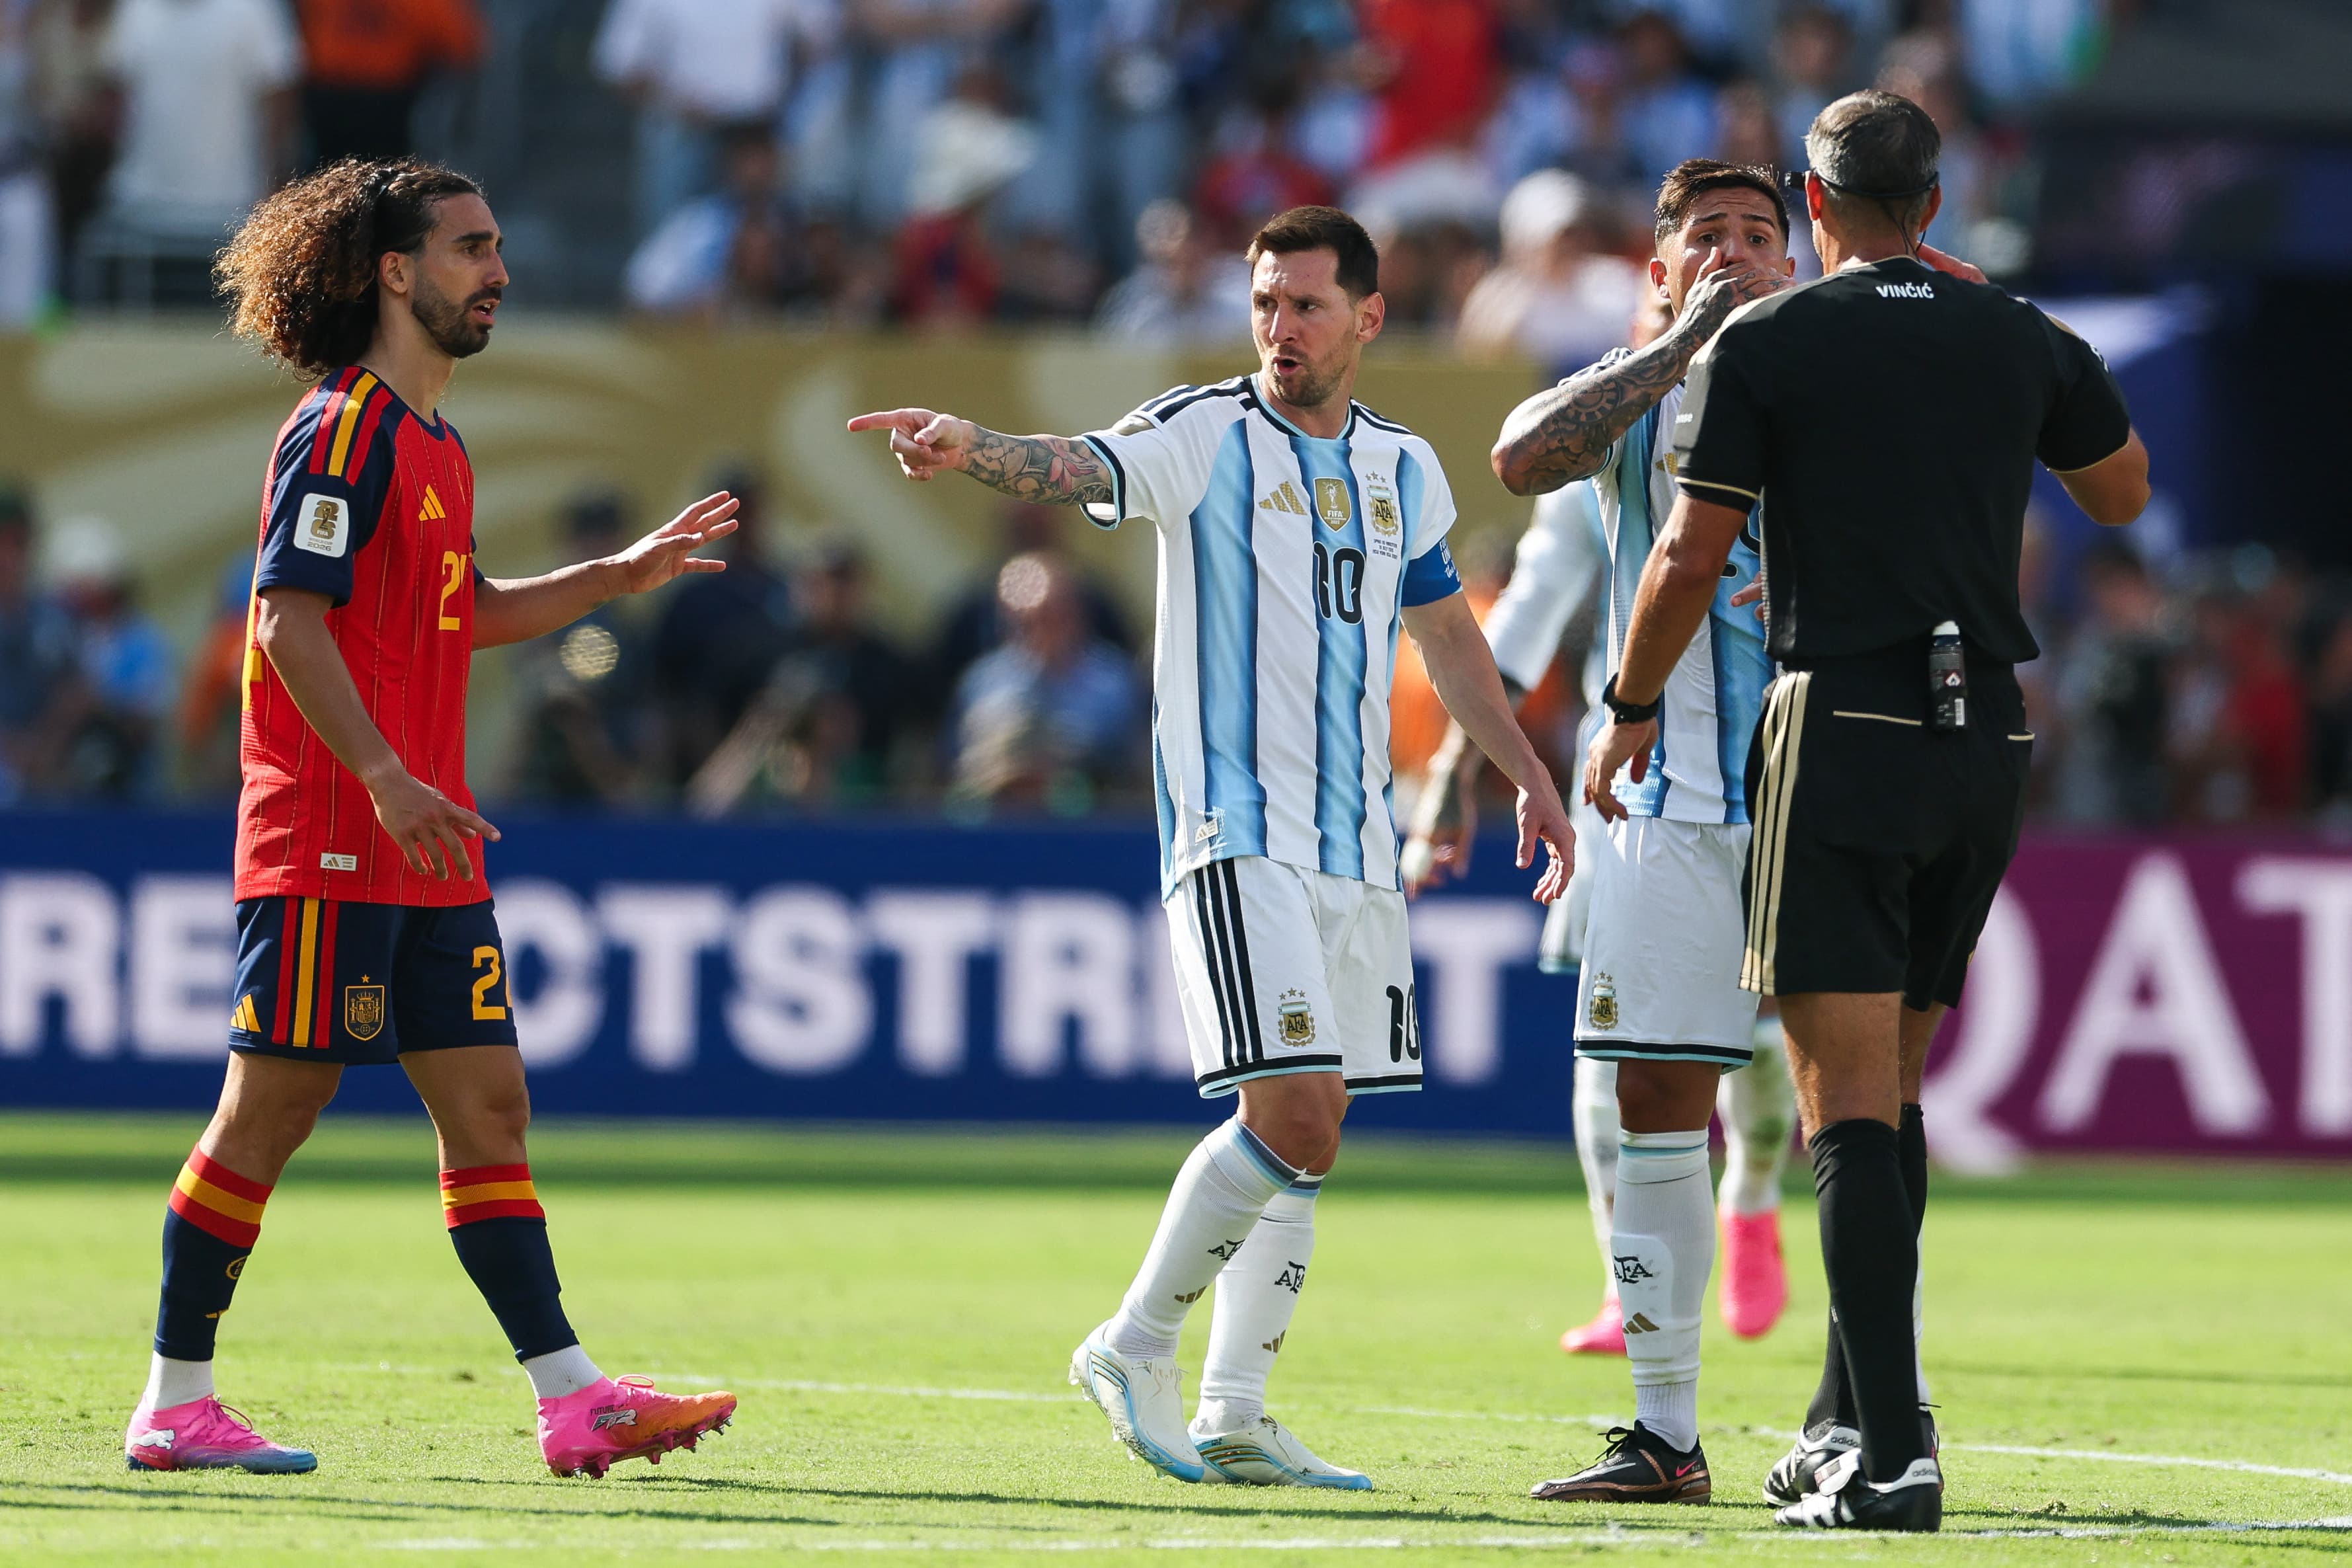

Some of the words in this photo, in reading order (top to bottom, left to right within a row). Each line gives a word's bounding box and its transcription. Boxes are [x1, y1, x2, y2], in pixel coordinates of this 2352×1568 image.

[1875, 282, 1934, 299] VINČIĆ
[1375, 499, 1393, 522] AFA
[307, 541, 332, 551] 2026
[438, 551, 467, 631] 2
[1313, 541, 1366, 625] 10
[472, 945, 514, 1021] 2
[1594, 997, 1612, 1018] AFA
[1286, 1013, 1309, 1034] AFA
[1386, 982, 1421, 1064] 10
